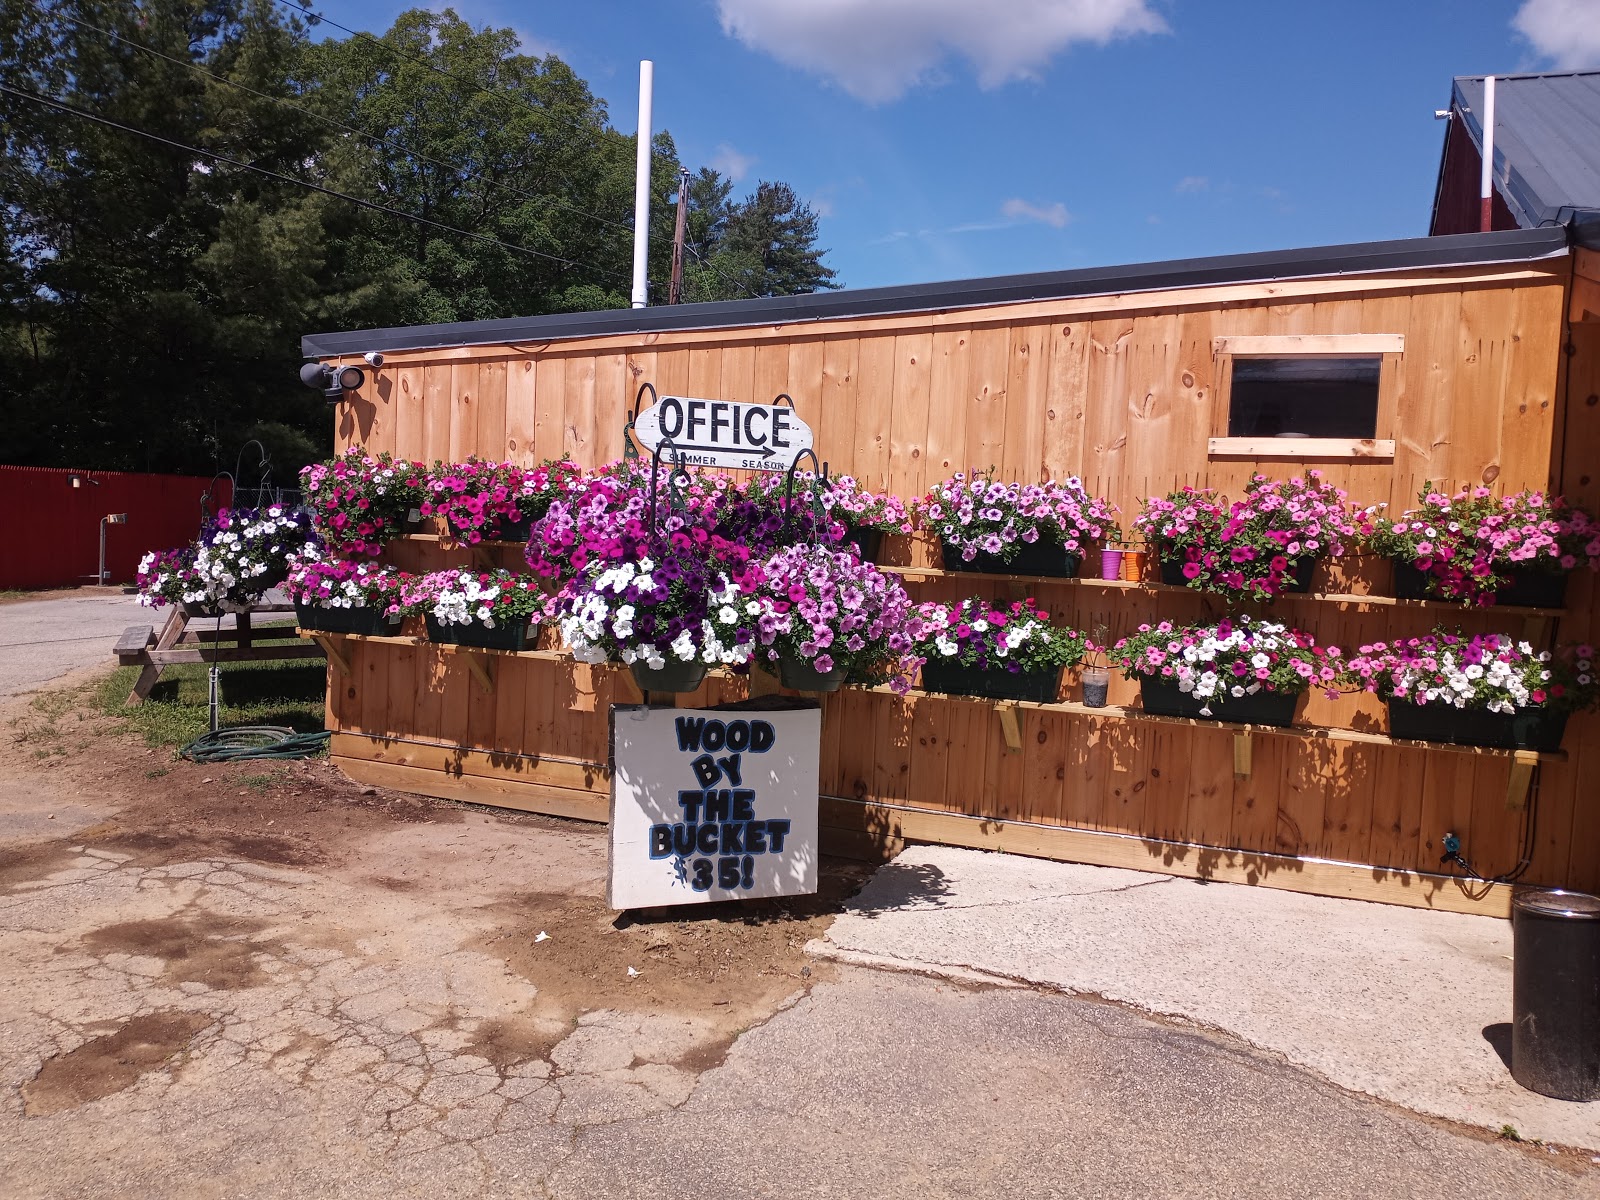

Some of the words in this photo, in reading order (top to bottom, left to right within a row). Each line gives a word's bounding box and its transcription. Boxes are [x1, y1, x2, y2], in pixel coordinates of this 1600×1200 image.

[658, 397, 791, 449] OFFICE
[741, 459, 785, 470] SEASON
[674, 716, 776, 753] WOOD
[690, 753, 742, 789] BY
[678, 789, 756, 823] THE
[649, 819, 791, 860] BUCKET
